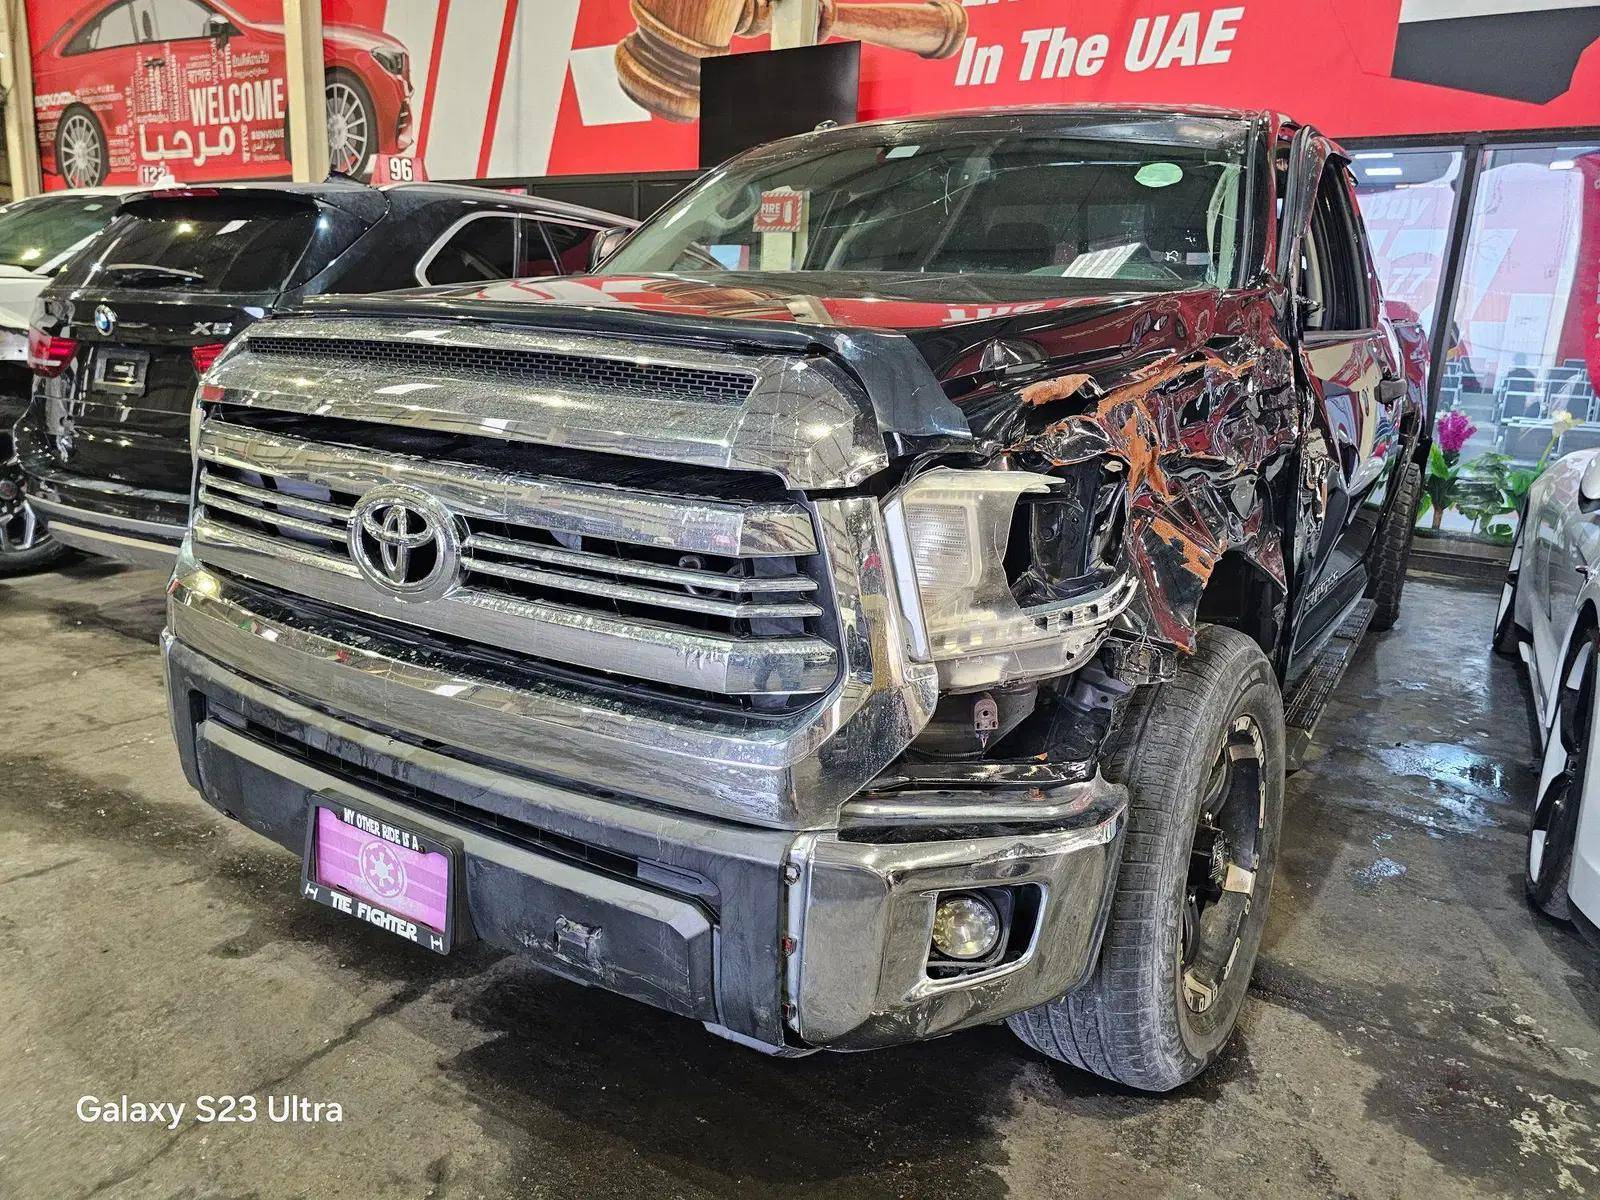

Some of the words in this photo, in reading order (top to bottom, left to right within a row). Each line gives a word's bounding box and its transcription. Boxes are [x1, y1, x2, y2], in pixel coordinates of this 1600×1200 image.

[954, 36, 1004, 86] In
[1018, 27, 1109, 81] The
[1124, 7, 1245, 72] UAE
[189, 78, 285, 126] WELCOME
[139, 124, 236, 167] مرحبا
[389, 157, 412, 182] 96
[761, 202, 781, 214] FIRE
[344, 807, 354, 826] MY
[356, 813, 381, 838] OTHER
[381, 823, 401, 847] RIDE
[412, 835, 419, 851] A
[331, 891, 353, 914] TIE
[357, 902, 418, 942] FIGHTER
